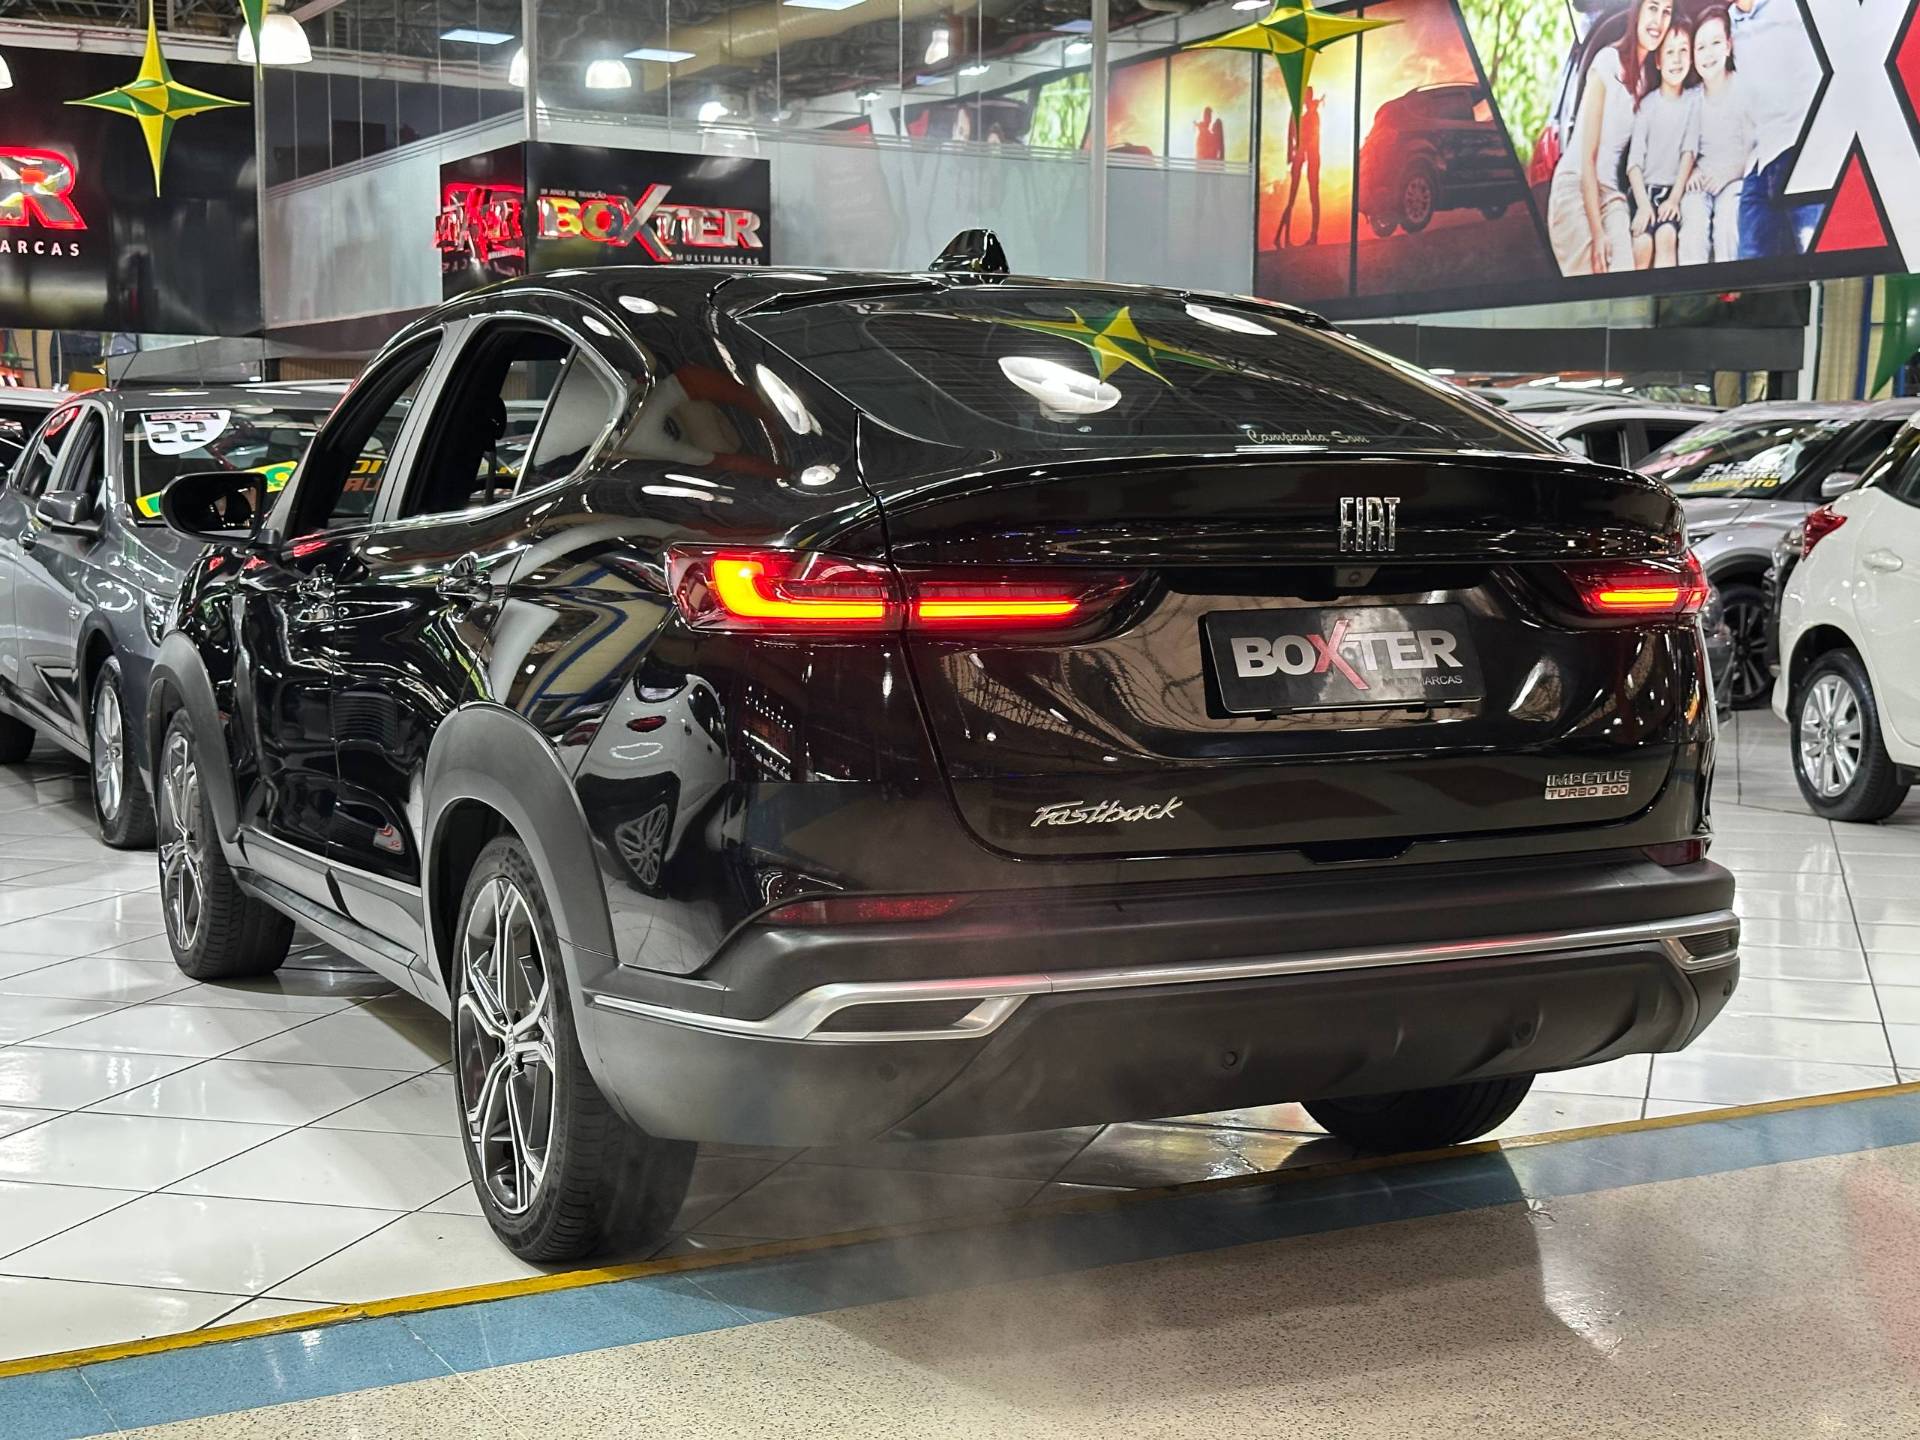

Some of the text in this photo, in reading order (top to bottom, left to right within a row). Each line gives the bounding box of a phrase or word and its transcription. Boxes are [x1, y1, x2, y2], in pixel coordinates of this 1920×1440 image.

[536, 183, 763, 263] BOXTER
[0, 240, 80, 256] ARCAS
[676, 253, 760, 265] MULTIMARCAS
[1340, 497, 1401, 552] FIAT
[1230, 619, 1464, 690] BOXTER
[1546, 770, 1631, 787] IMPETUS
[1548, 784, 1628, 799] TURBO 200
[1030, 796, 1184, 827] Fastback
